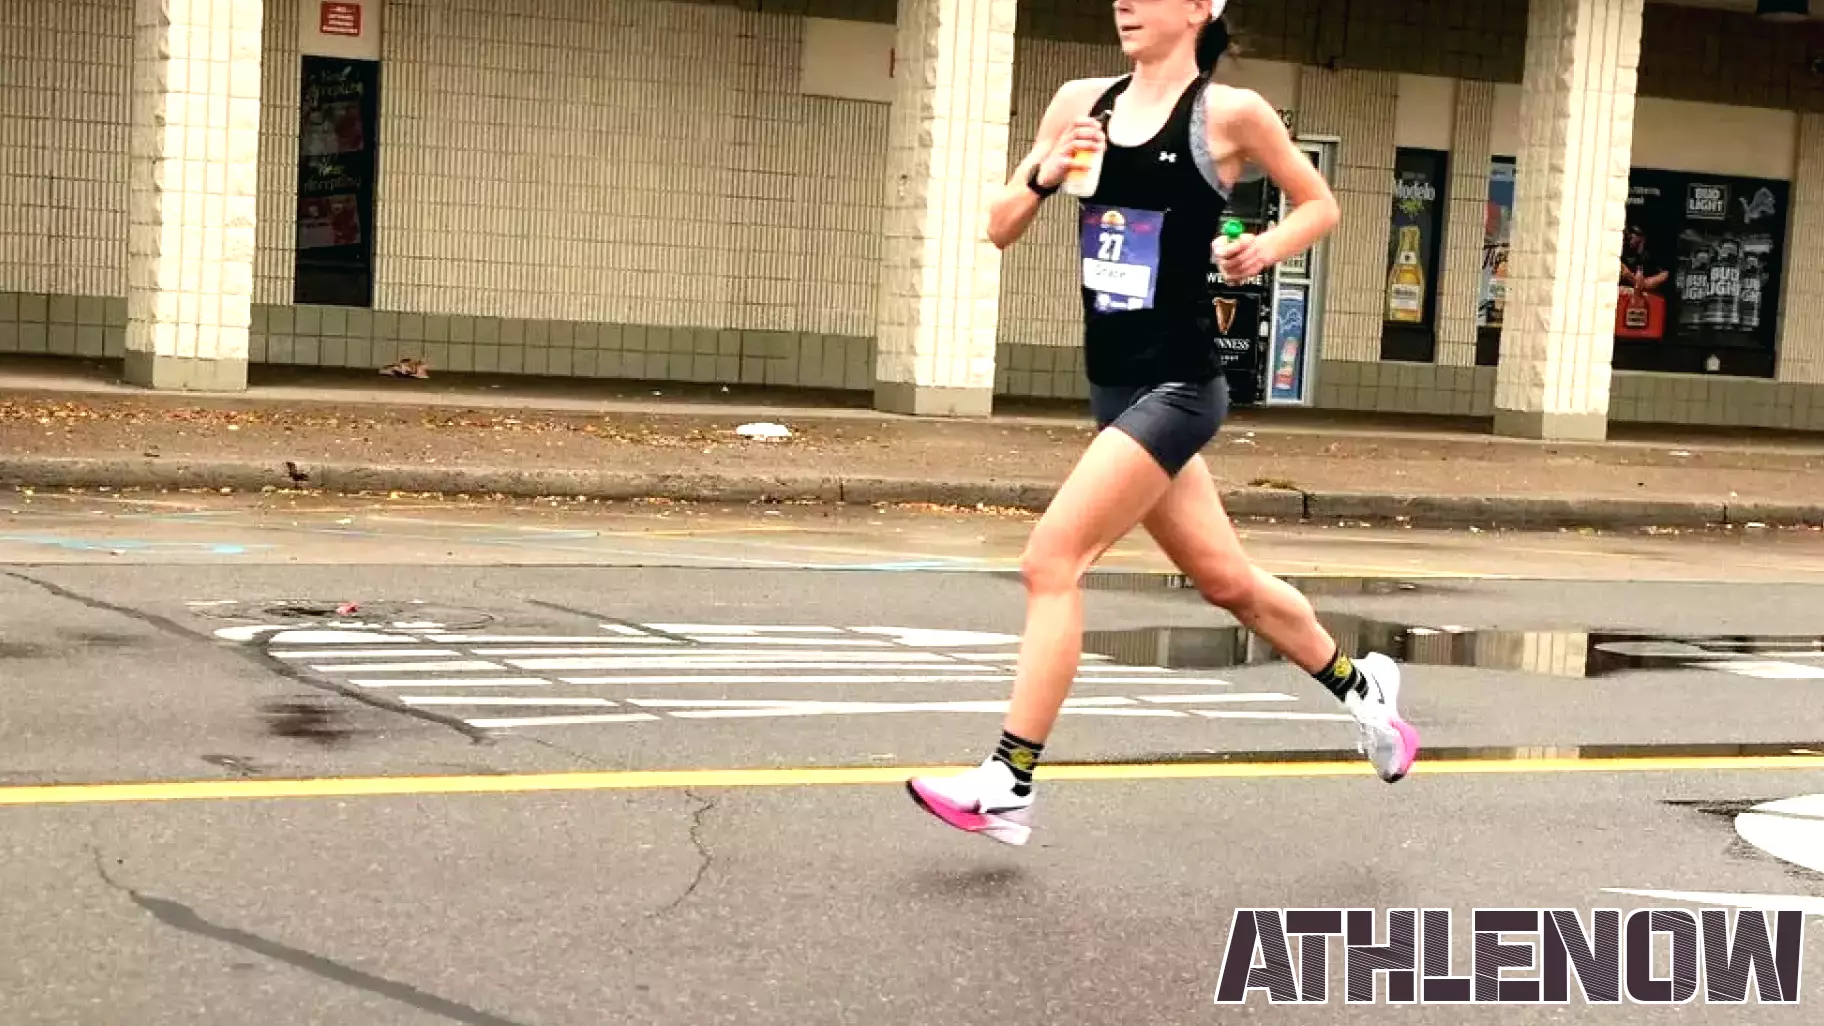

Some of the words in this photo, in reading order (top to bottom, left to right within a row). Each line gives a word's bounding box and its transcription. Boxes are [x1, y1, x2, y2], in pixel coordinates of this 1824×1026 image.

[1695, 187, 1720, 198] BUD
[1689, 197, 1722, 211] LIGHT
[1098, 232, 1124, 261] 27
[1711, 267, 1739, 281] BUD
